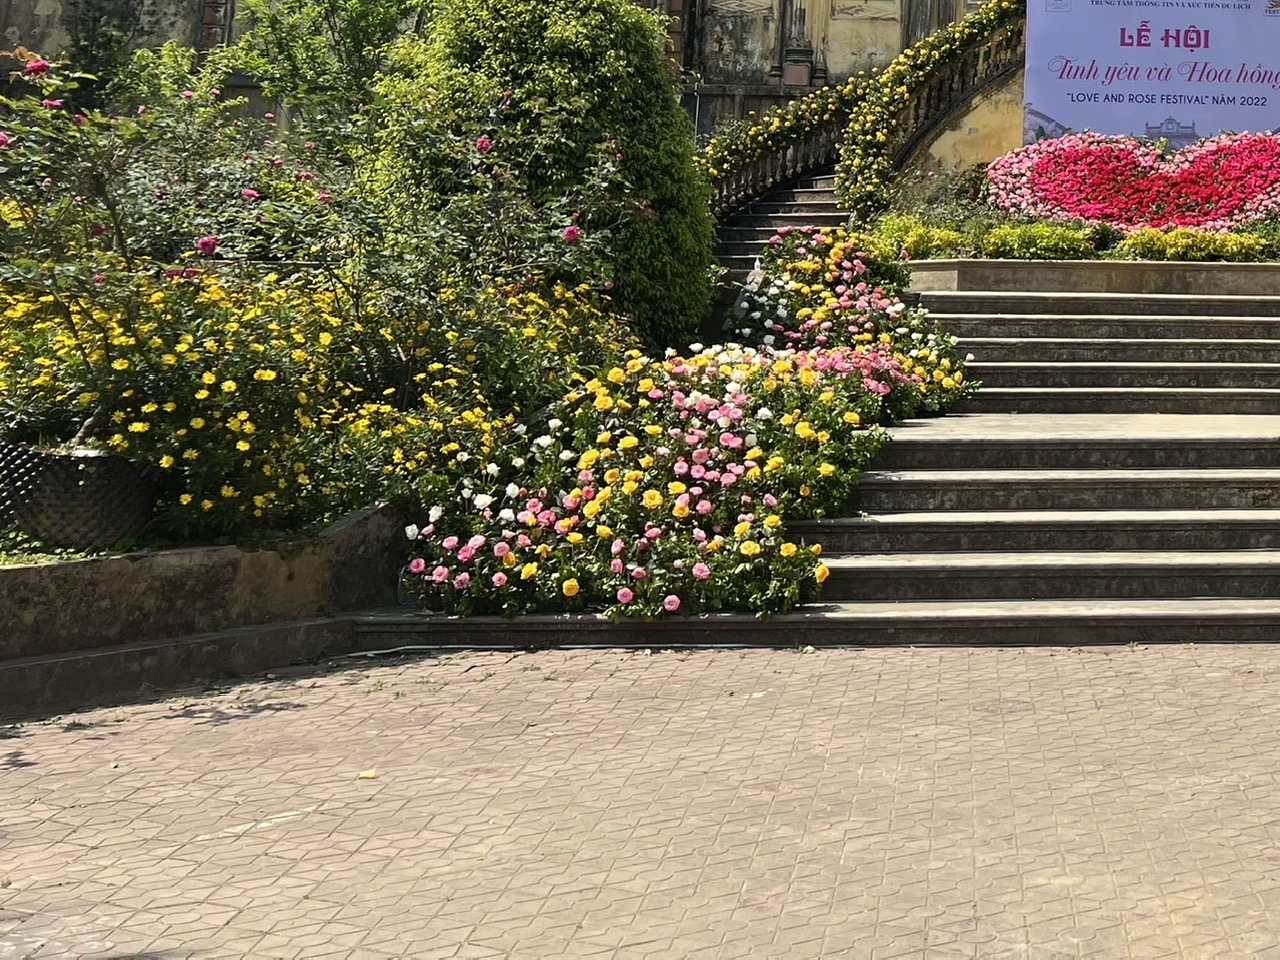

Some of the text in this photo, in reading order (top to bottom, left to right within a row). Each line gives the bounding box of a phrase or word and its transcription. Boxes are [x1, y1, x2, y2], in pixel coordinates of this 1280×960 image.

[1120, 20, 1210, 52] LỄ HỘI
[1101, 62, 1140, 87] yêu
[1146, 63, 1173, 81] và
[1178, 61, 1232, 84] Hoa
[1103, 94, 1124, 103] AND
[1129, 94, 1156, 104] ROSE
[1212, 94, 1235, 105] NĂM
[1240, 96, 1267, 106] 2022
